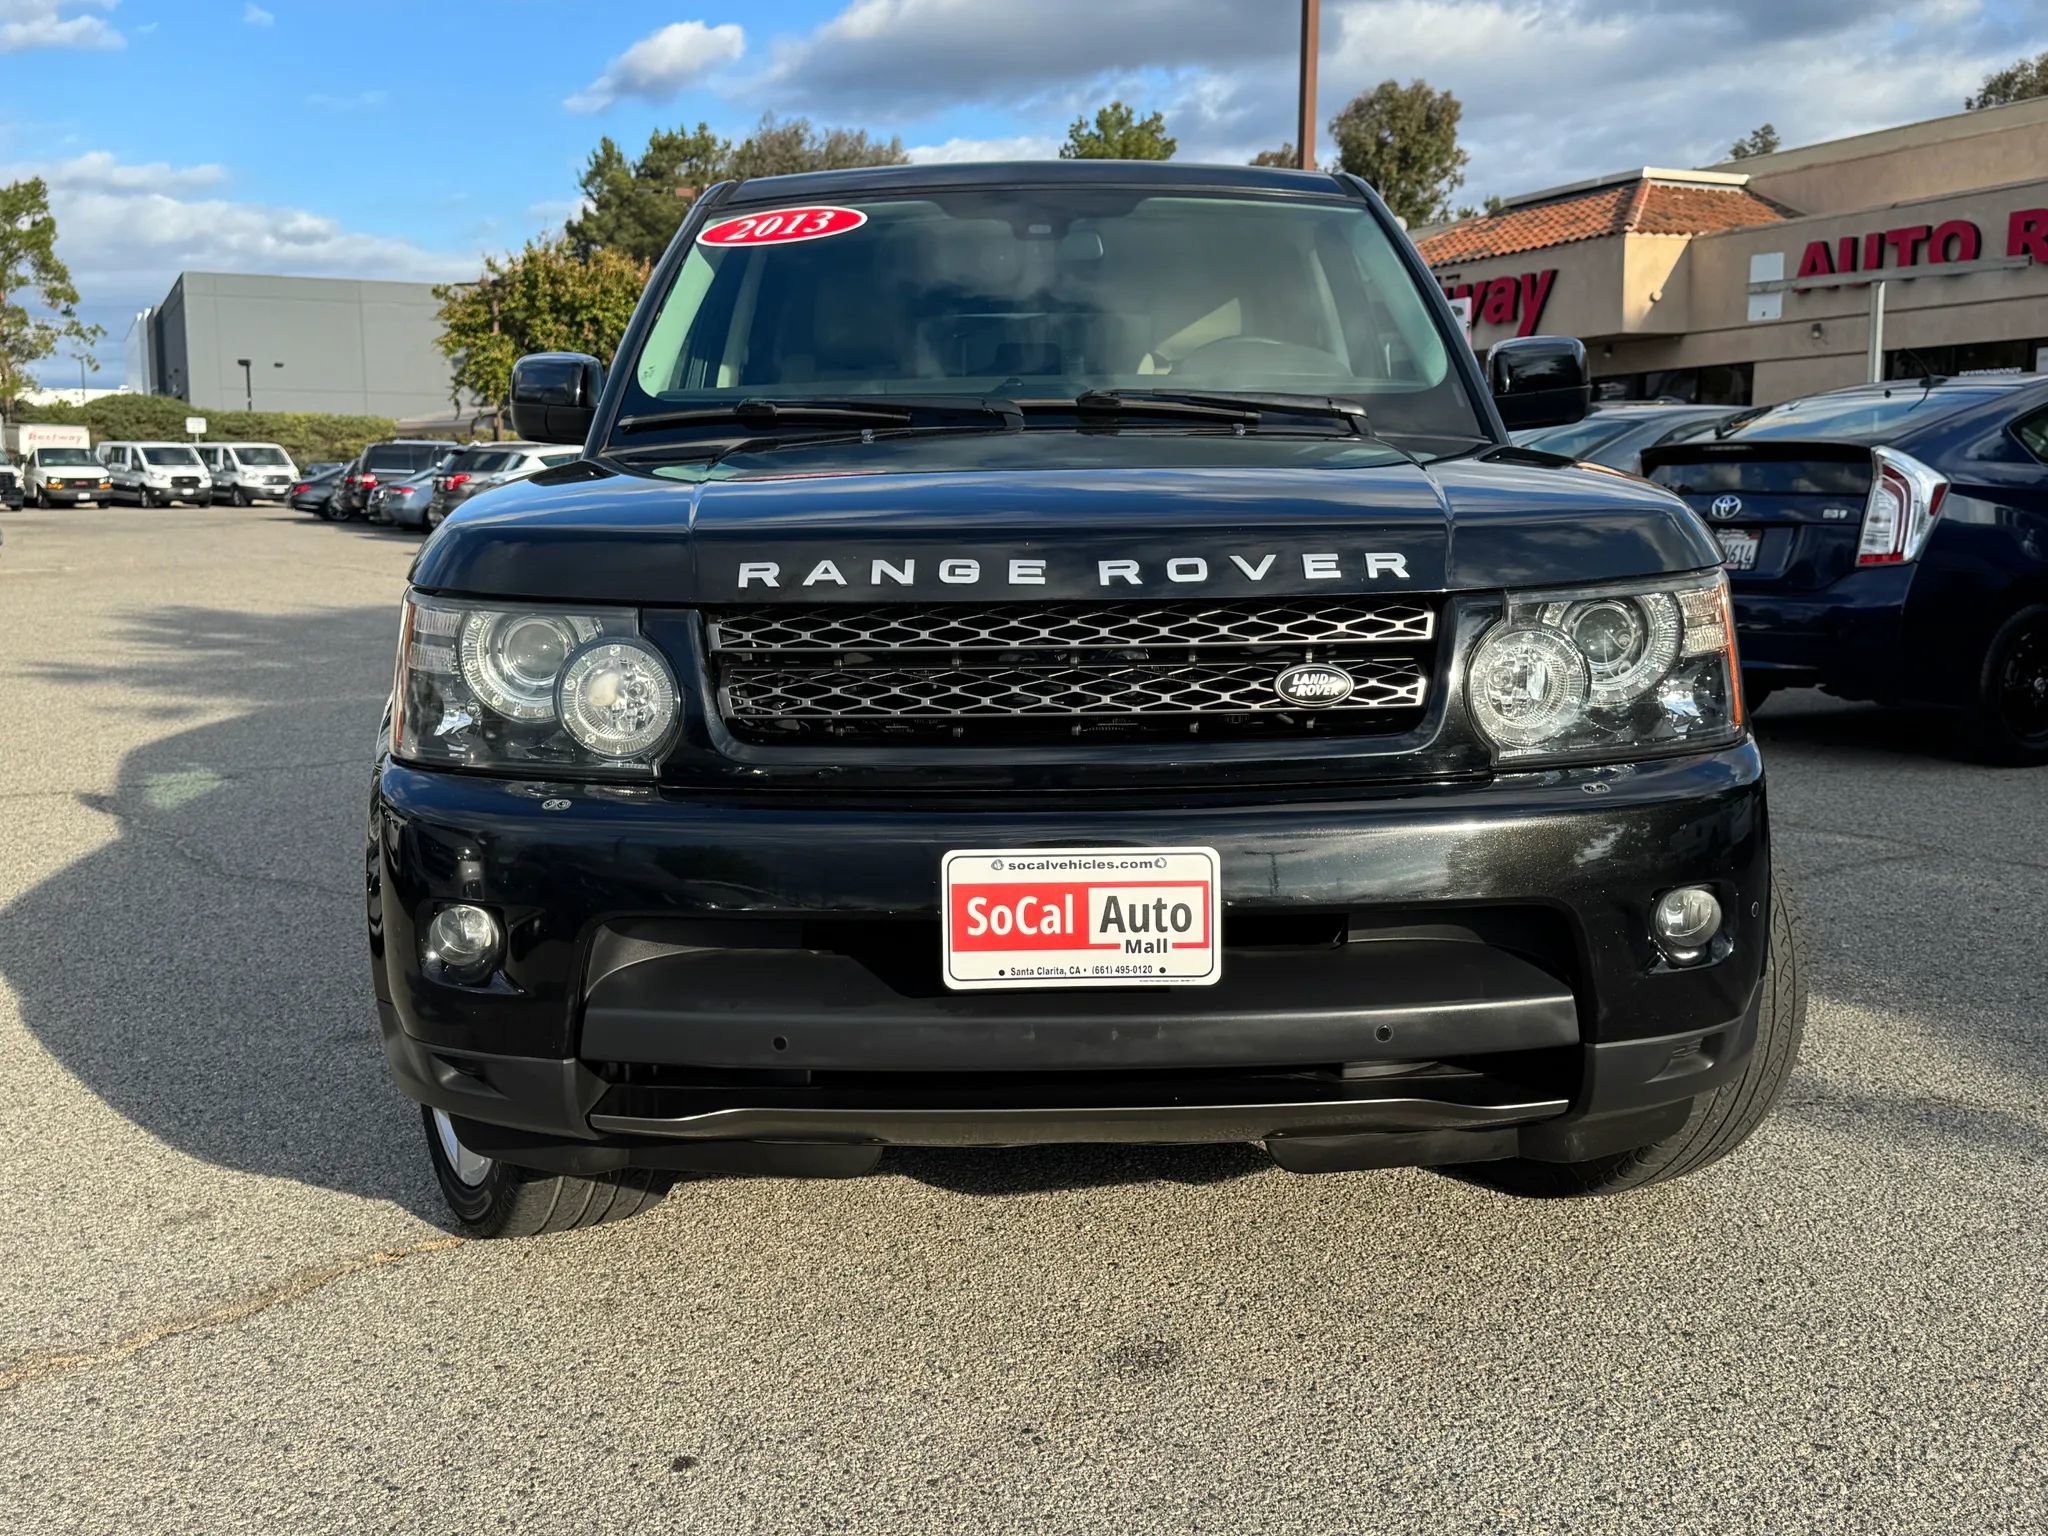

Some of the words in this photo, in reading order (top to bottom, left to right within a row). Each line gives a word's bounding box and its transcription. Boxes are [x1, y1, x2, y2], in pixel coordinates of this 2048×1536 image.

[724, 211, 836, 241] 2013
[1794, 219, 1982, 294] AUTO
[738, 558, 1047, 588] RANGE
[1098, 552, 1411, 586] ROVER
[1292, 673, 1329, 685] LAND
[1295, 684, 1339, 697] ROVER
[1008, 858, 1153, 871] socalvehicles.com
[967, 893, 1074, 936] SoCal
[1099, 895, 1192, 934] Auto
[1125, 938, 1168, 954] Mall
[1010, 967, 1035, 977] Santa
[1036, 966, 1067, 978] Clarita,
[1069, 966, 1081, 975] CA
[1091, 965, 1113, 975] (661)
[1115, 964, 1153, 975] 495-0120
